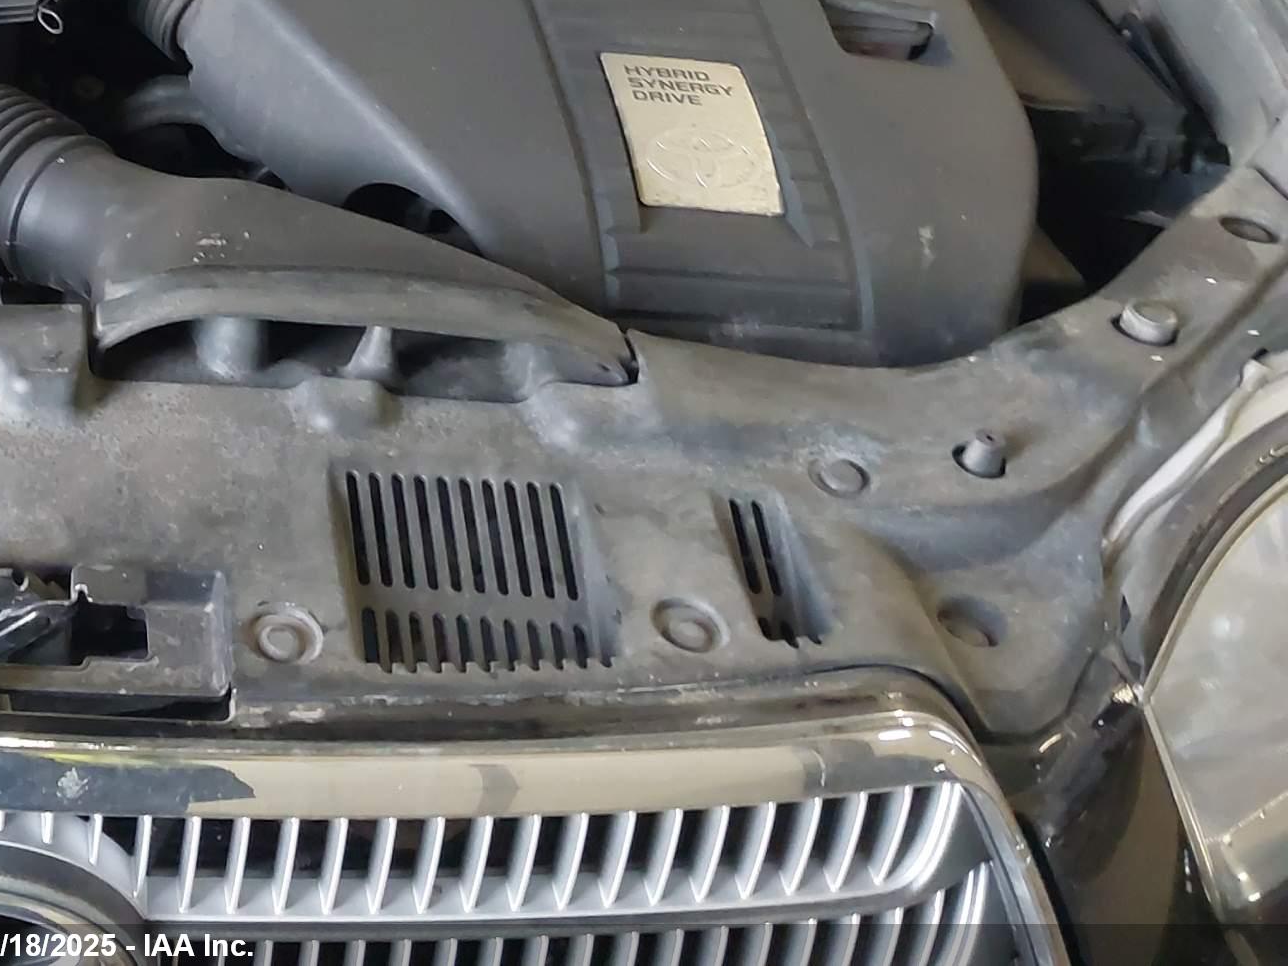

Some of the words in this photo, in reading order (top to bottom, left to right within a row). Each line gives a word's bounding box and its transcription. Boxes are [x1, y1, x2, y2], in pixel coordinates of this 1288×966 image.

[623, 64, 710, 82] HYBRID
[627, 77, 734, 97] SYNERGY
[632, 90, 703, 106] DRIVE
